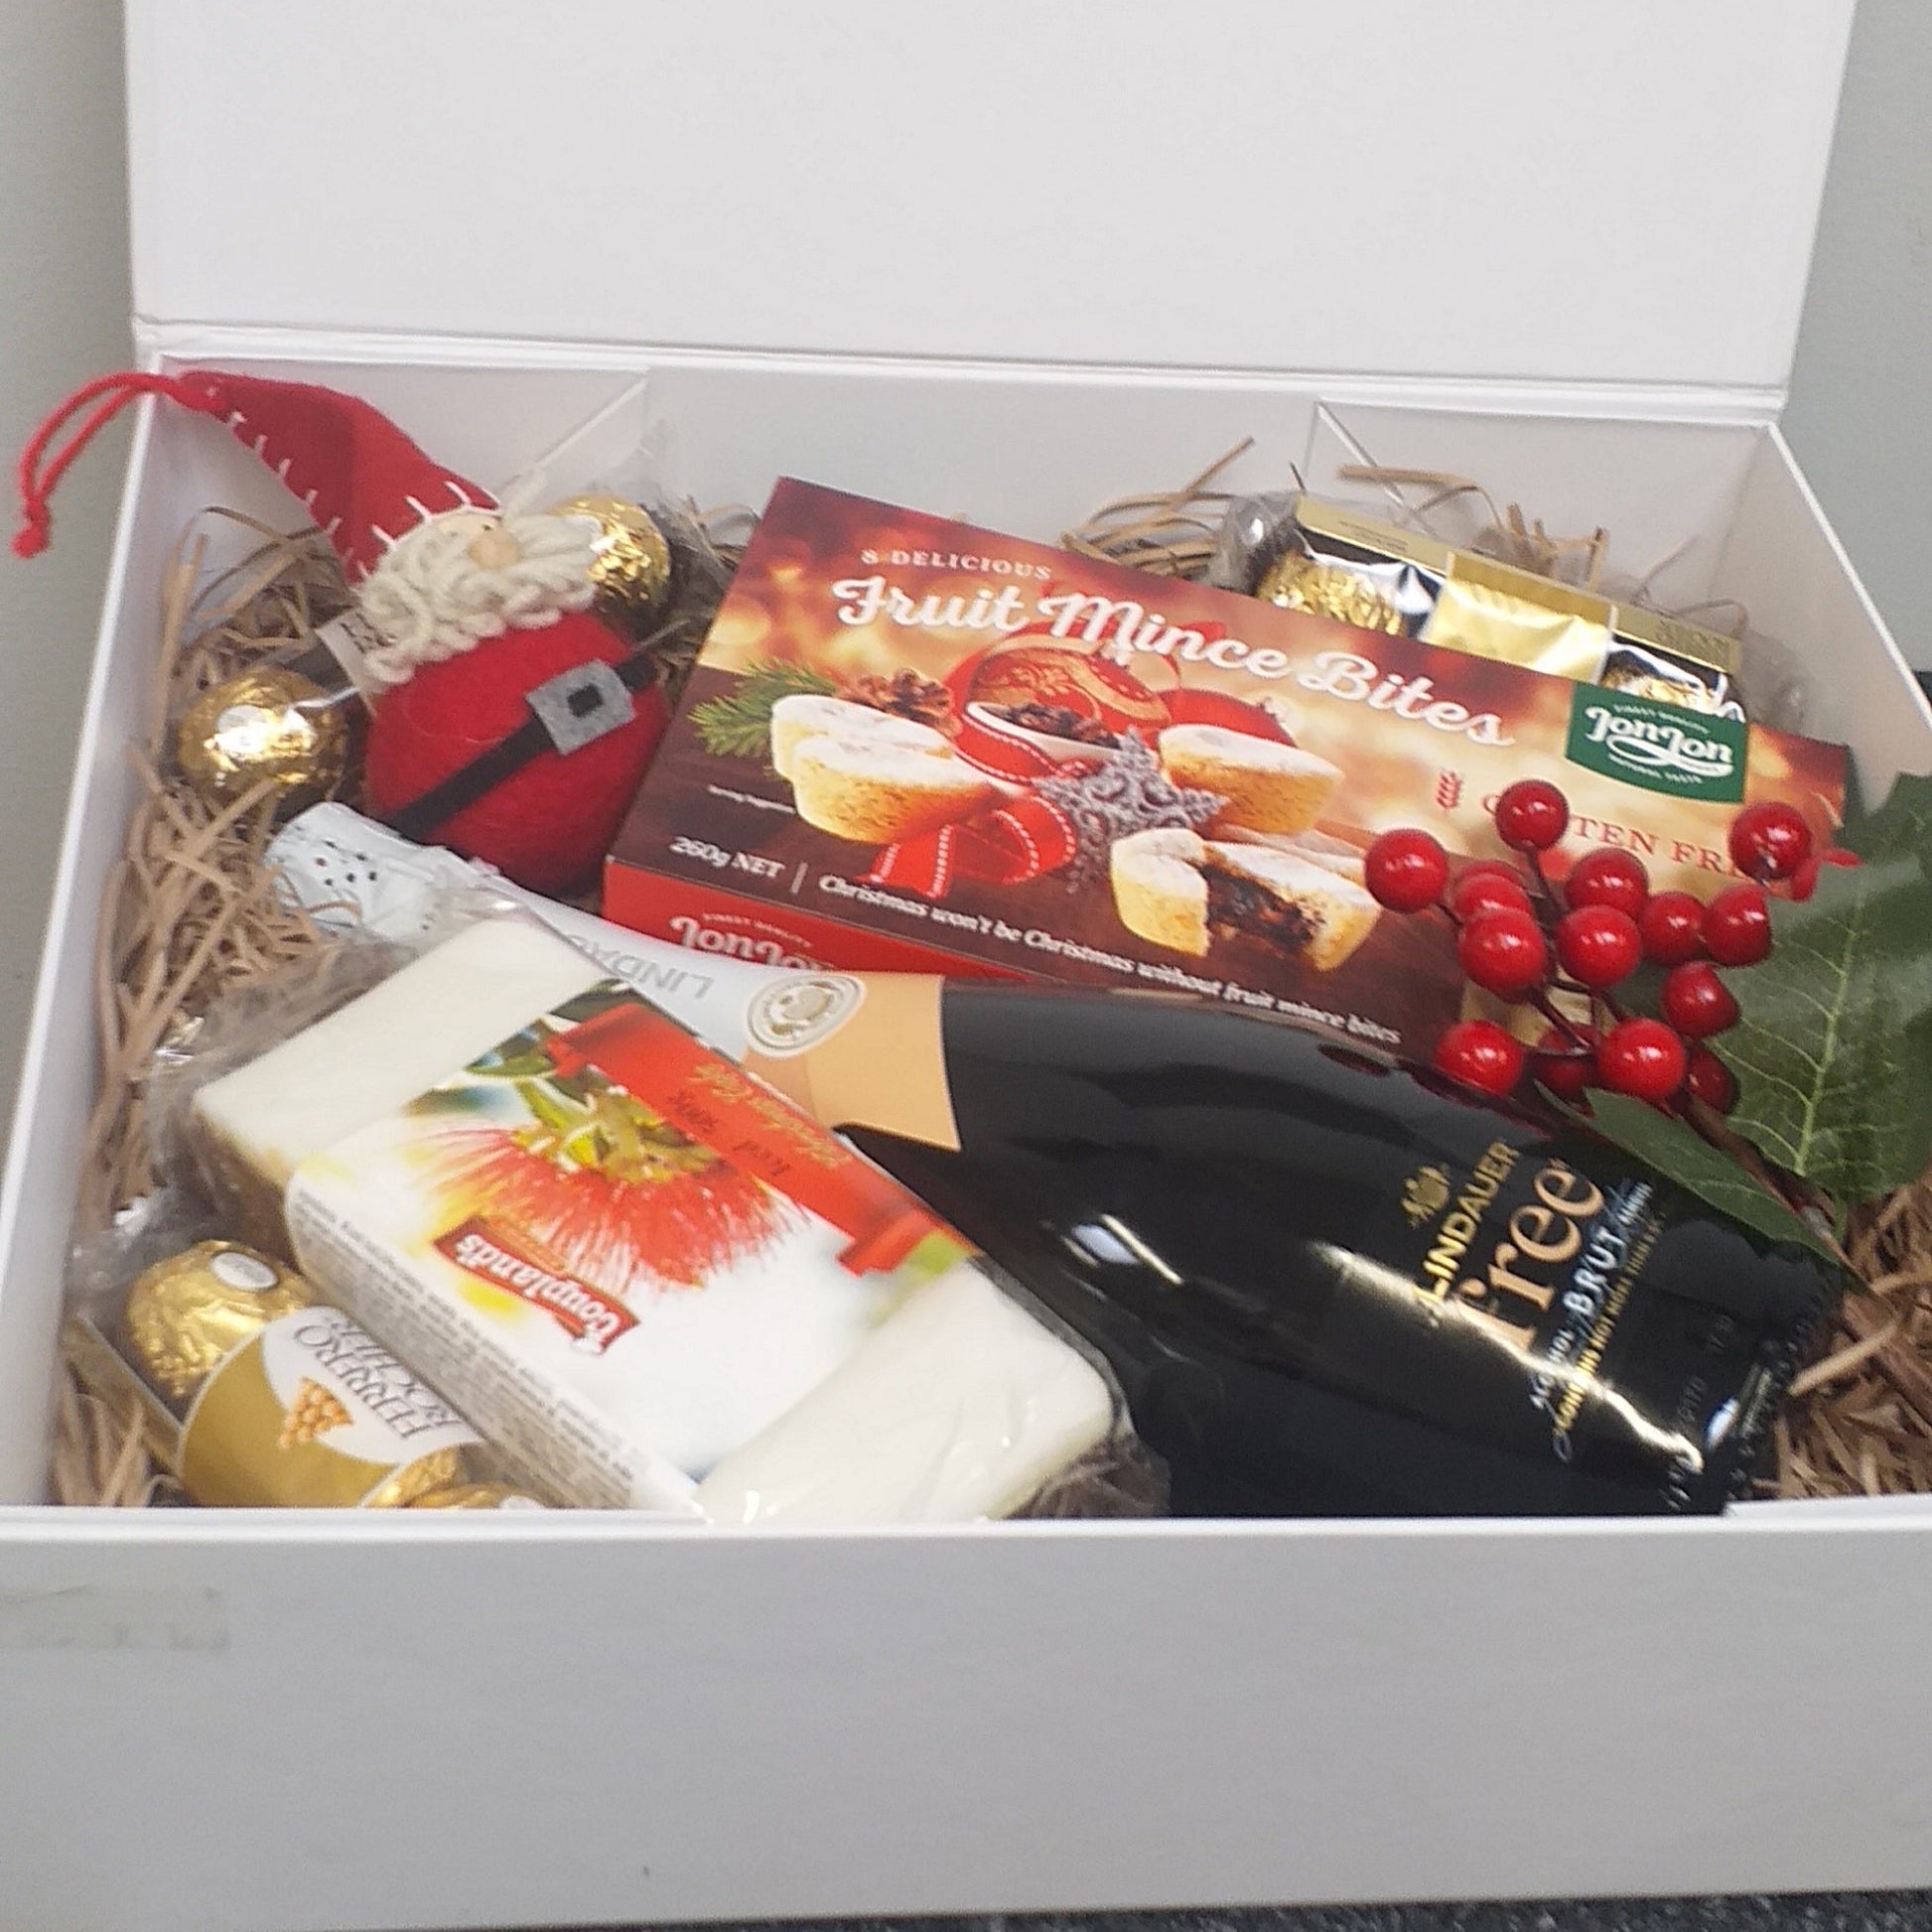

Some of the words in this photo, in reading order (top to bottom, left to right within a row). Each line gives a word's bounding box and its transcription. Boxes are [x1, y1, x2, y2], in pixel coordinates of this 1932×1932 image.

[860, 548, 880, 565] 8
[891, 548, 1052, 581] DELICIOUS
[831, 575, 1031, 632] Fruit
[1036, 592, 1292, 679] Mince
[1297, 650, 1515, 748] Bites
[731, 851, 786, 879] NET
[1672, 840, 1750, 880] FR
[818, 874, 928, 918] Christmas
[930, 904, 993, 935] won't
[993, 919, 1024, 942] be
[1024, 928, 1134, 973] Christmas
[1136, 961, 1223, 997] without
[1222, 981, 1277, 1010] fruit
[1276, 999, 1347, 1028] mince
[1346, 1012, 1402, 1044] bites
[1414, 1139, 1521, 1303] LINDAUER
[1456, 1162, 1604, 1351] free
[1562, 1226, 1627, 1318] BRUT
[294, 1324, 431, 1439] FERRERO
